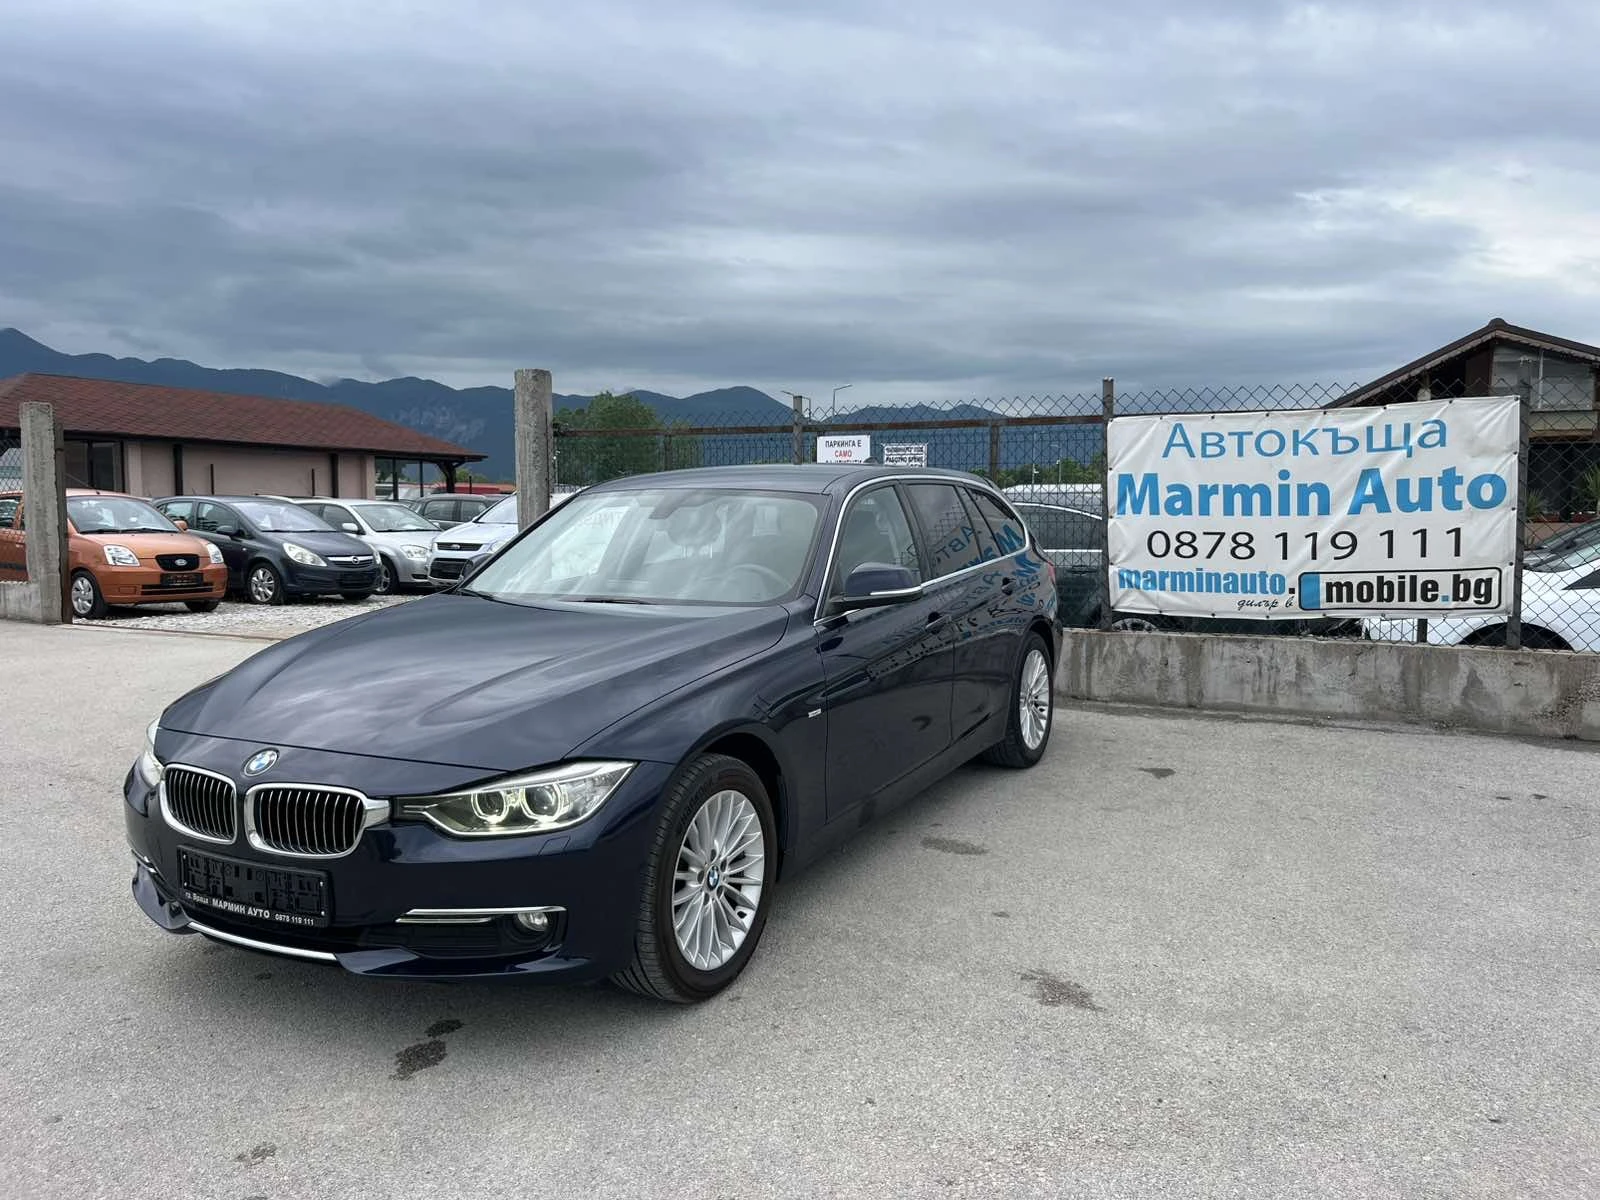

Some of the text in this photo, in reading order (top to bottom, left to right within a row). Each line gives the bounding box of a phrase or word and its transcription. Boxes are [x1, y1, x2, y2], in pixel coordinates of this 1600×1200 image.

[825, 440, 856, 448] ПАРКИНГА
[834, 449, 853, 457] САМО
[1162, 418, 1447, 459] Автокъща
[1116, 466, 1507, 517] Marmin Auto
[1147, 527, 1463, 561] 0878 119 111
[1325, 573, 1493, 604] mobile.bg
[212, 898, 246, 915] МАРМИН
[247, 906, 270, 918] АУТО
[303, 917, 314, 926] 111
